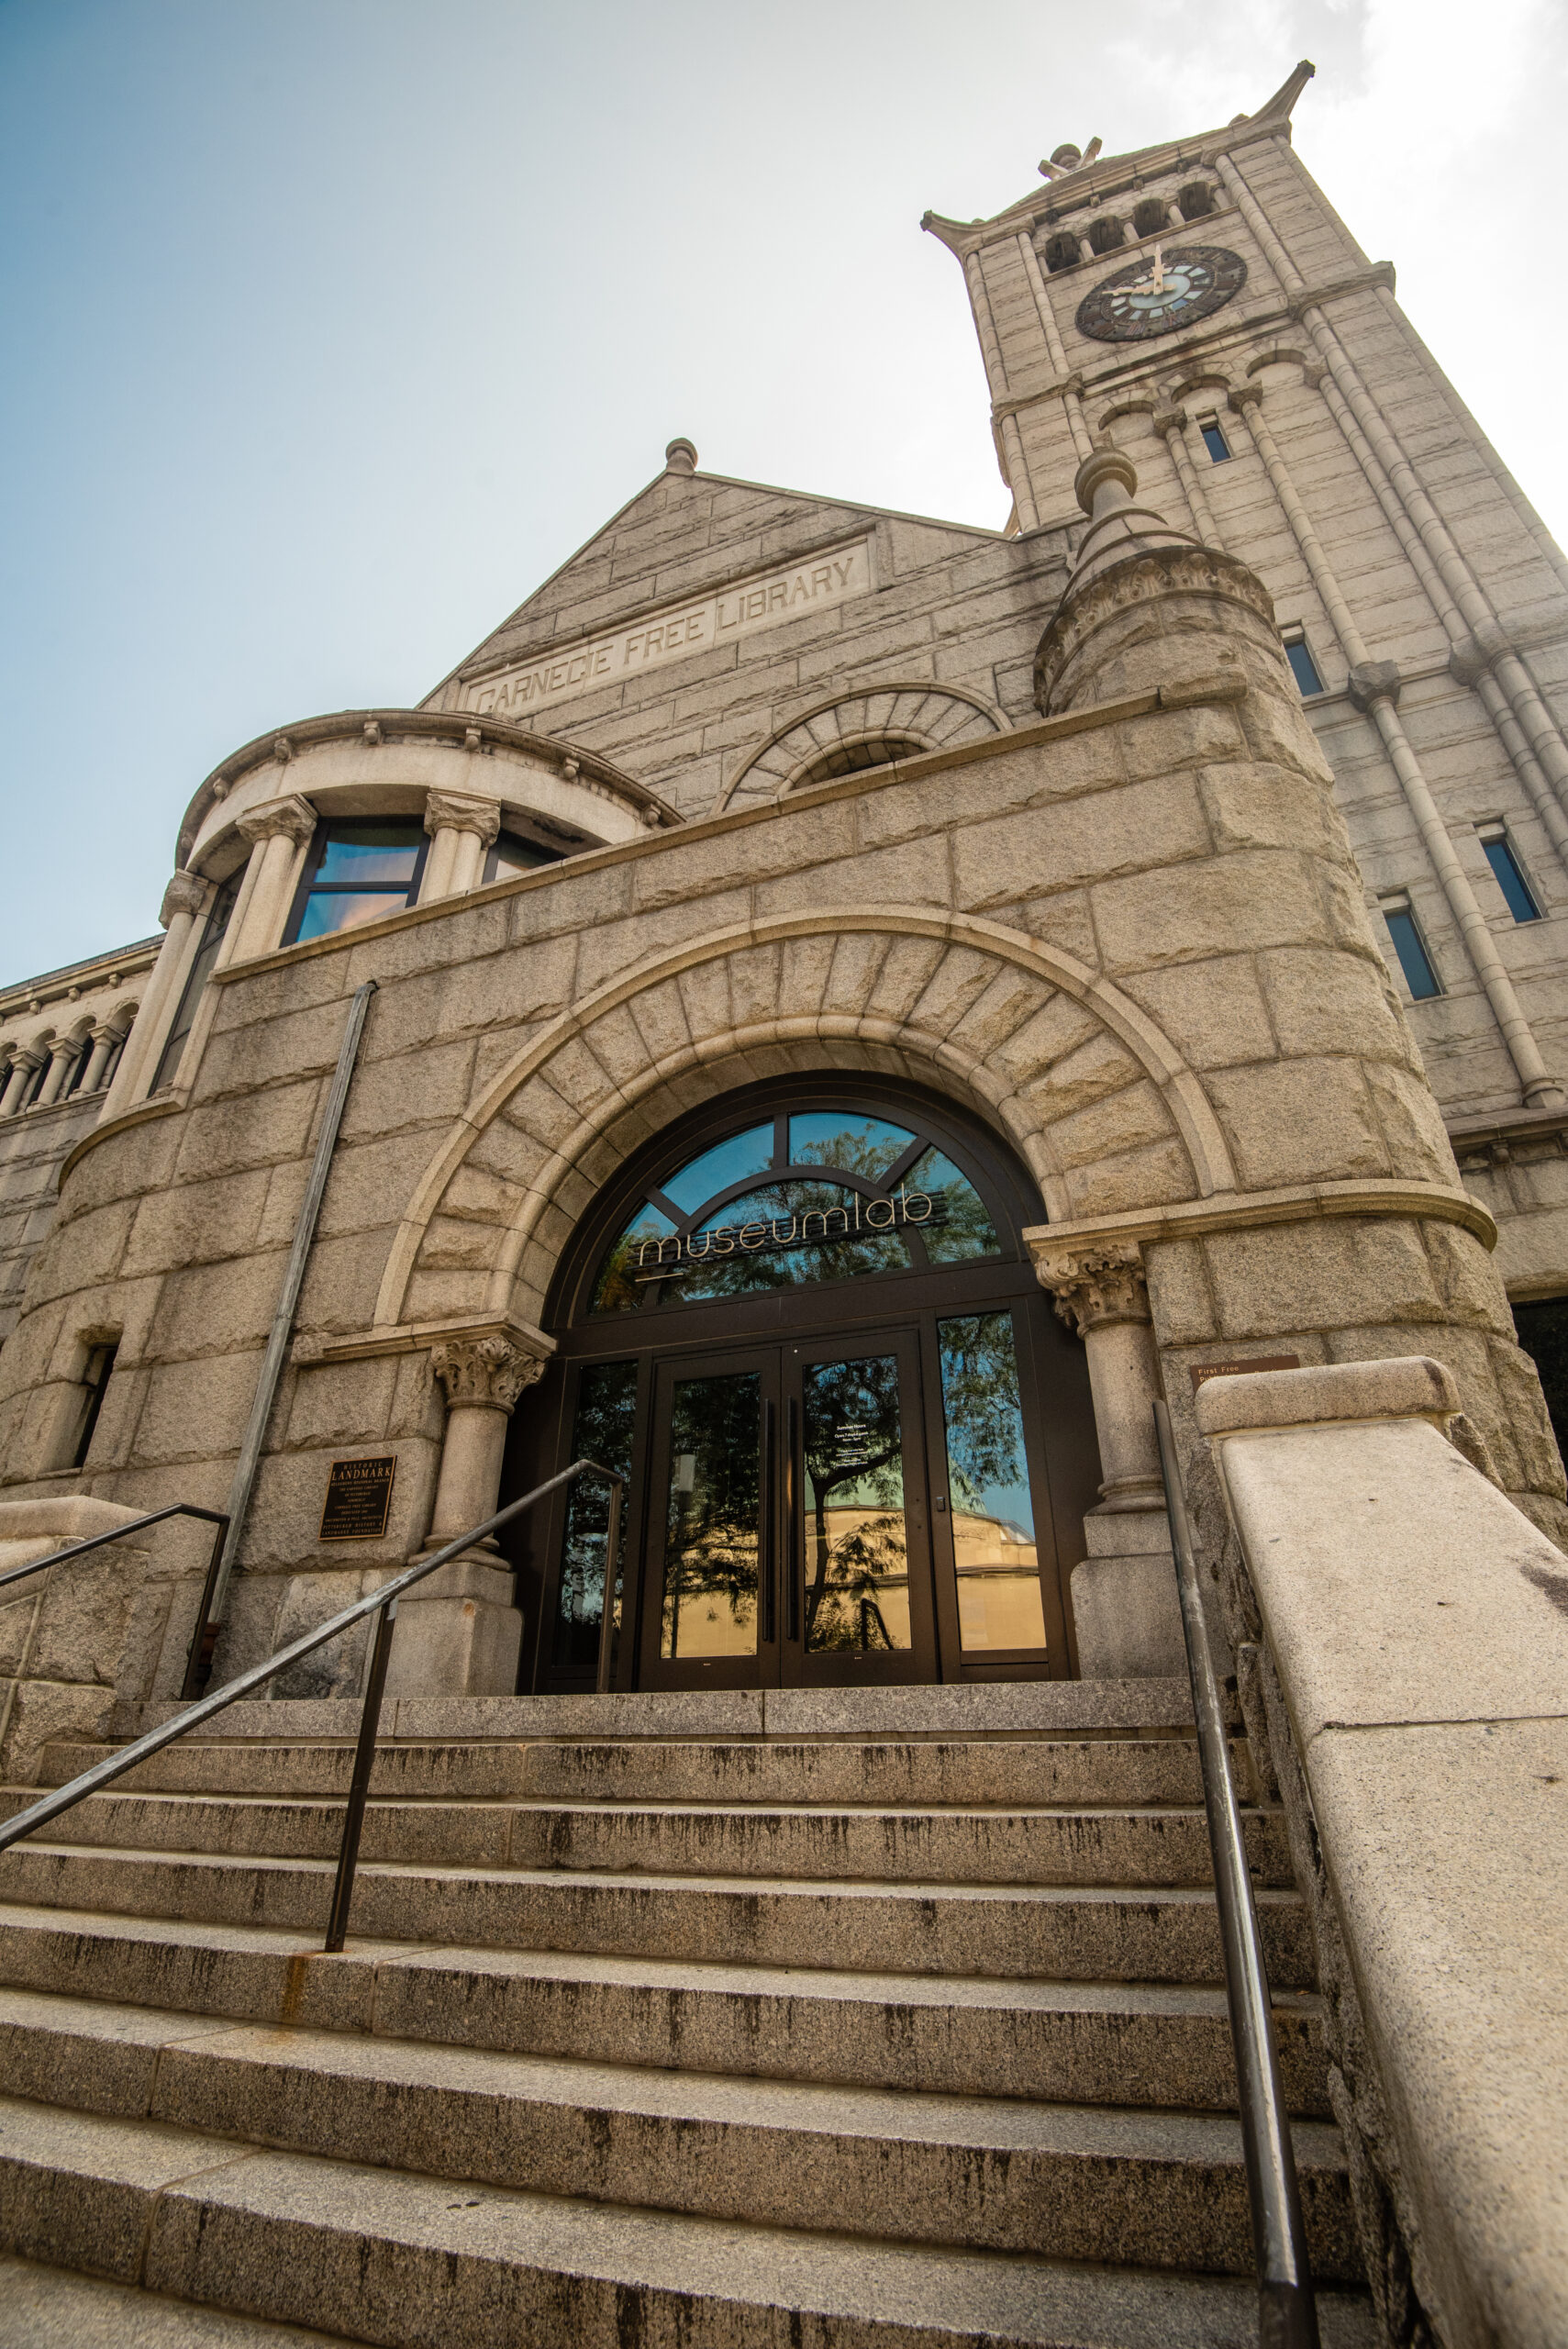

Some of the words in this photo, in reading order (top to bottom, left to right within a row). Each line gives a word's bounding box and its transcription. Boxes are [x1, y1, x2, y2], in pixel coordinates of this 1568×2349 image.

[475, 644, 614, 713] CARNEGIE
[624, 610, 706, 665] FREE
[717, 557, 853, 631] LIBRARY
[639, 1183, 932, 1266] museumlab
[1197, 1367, 1218, 1375] First
[331, 1466, 391, 1480] LANDMARK
[343, 1462, 383, 1470] HISTORIC
